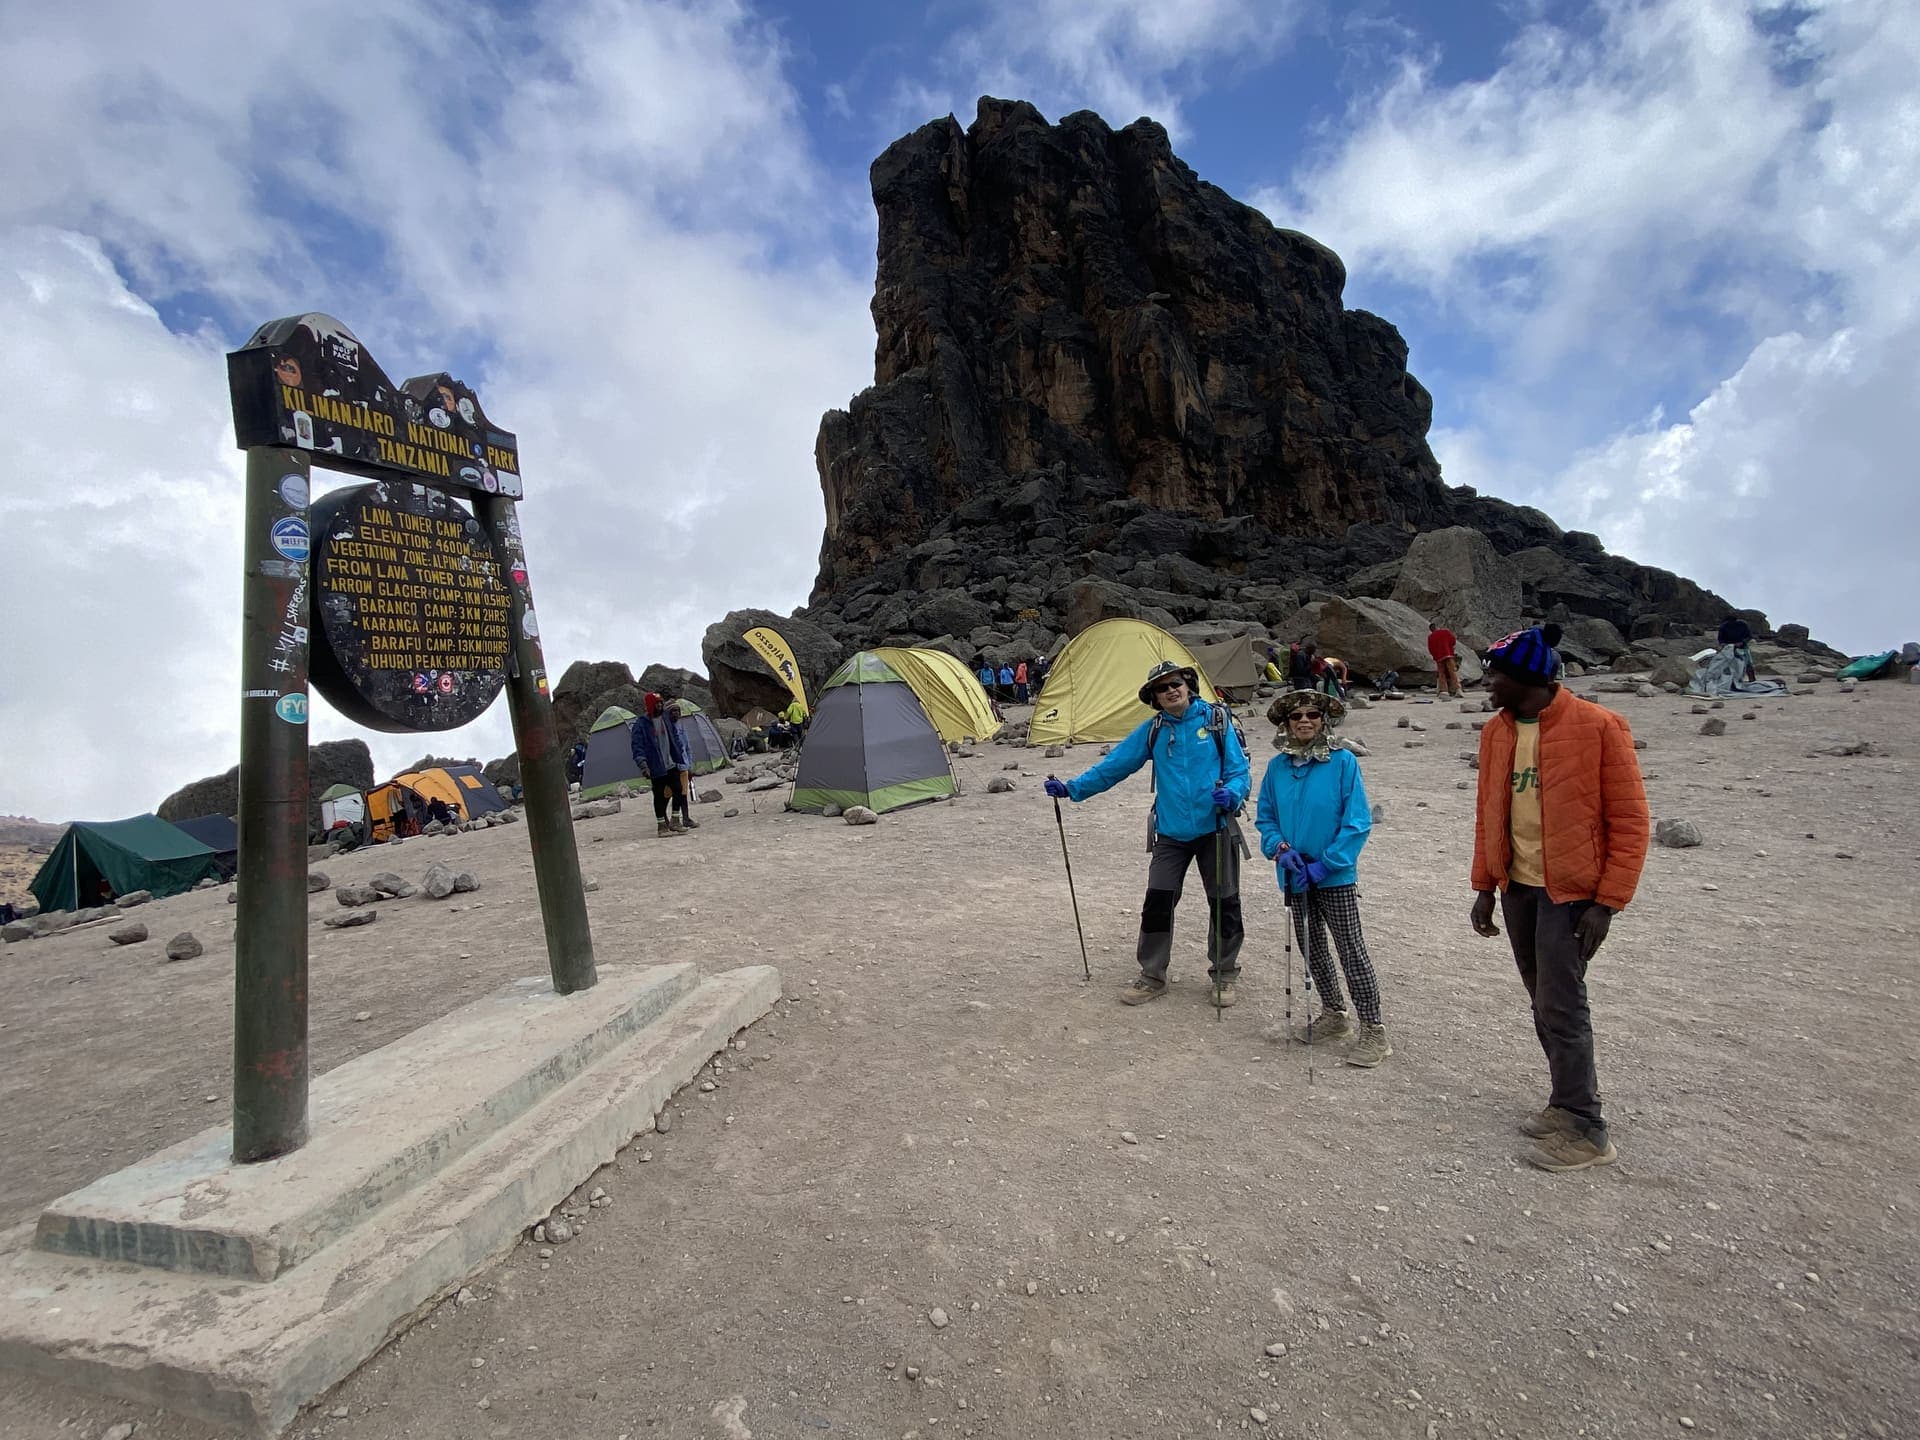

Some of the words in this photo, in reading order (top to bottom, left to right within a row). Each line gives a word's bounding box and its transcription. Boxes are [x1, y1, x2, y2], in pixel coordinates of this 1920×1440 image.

[282, 385, 395, 437] KILIMANJARO
[407, 421, 475, 460] NATIONAL
[487, 445, 517, 472] PARK
[376, 437, 451, 477] TANZANIA
[362, 505, 394, 527] LAVA
[396, 512, 433, 534] TOWER
[436, 520, 463, 539] CAMP
[360, 525, 432, 549] ELEVATION:
[435, 538, 471, 556] 4600M
[326, 557, 372, 577] FROM
[376, 563, 409, 581] LAVA
[415, 568, 455, 586] TOWER
[458, 574, 486, 590] CAMP
[329, 540, 398, 562] VEGETATION
[402, 549, 432, 567] ZONE:
[470, 559, 502, 577] DEERT
[331, 577, 373, 595] ARROW
[378, 581, 428, 600] GLACIER
[424, 603, 458, 619] CAMP:
[362, 616, 420, 633] KARANGA
[425, 620, 456, 635] CAMP:
[458, 622, 481, 637] 9KM
[481, 621, 510, 640] (6HRS)
[372, 635, 422, 651] BARAFU
[426, 637, 456, 652] CAMP:
[370, 653, 413, 670] UHURU
